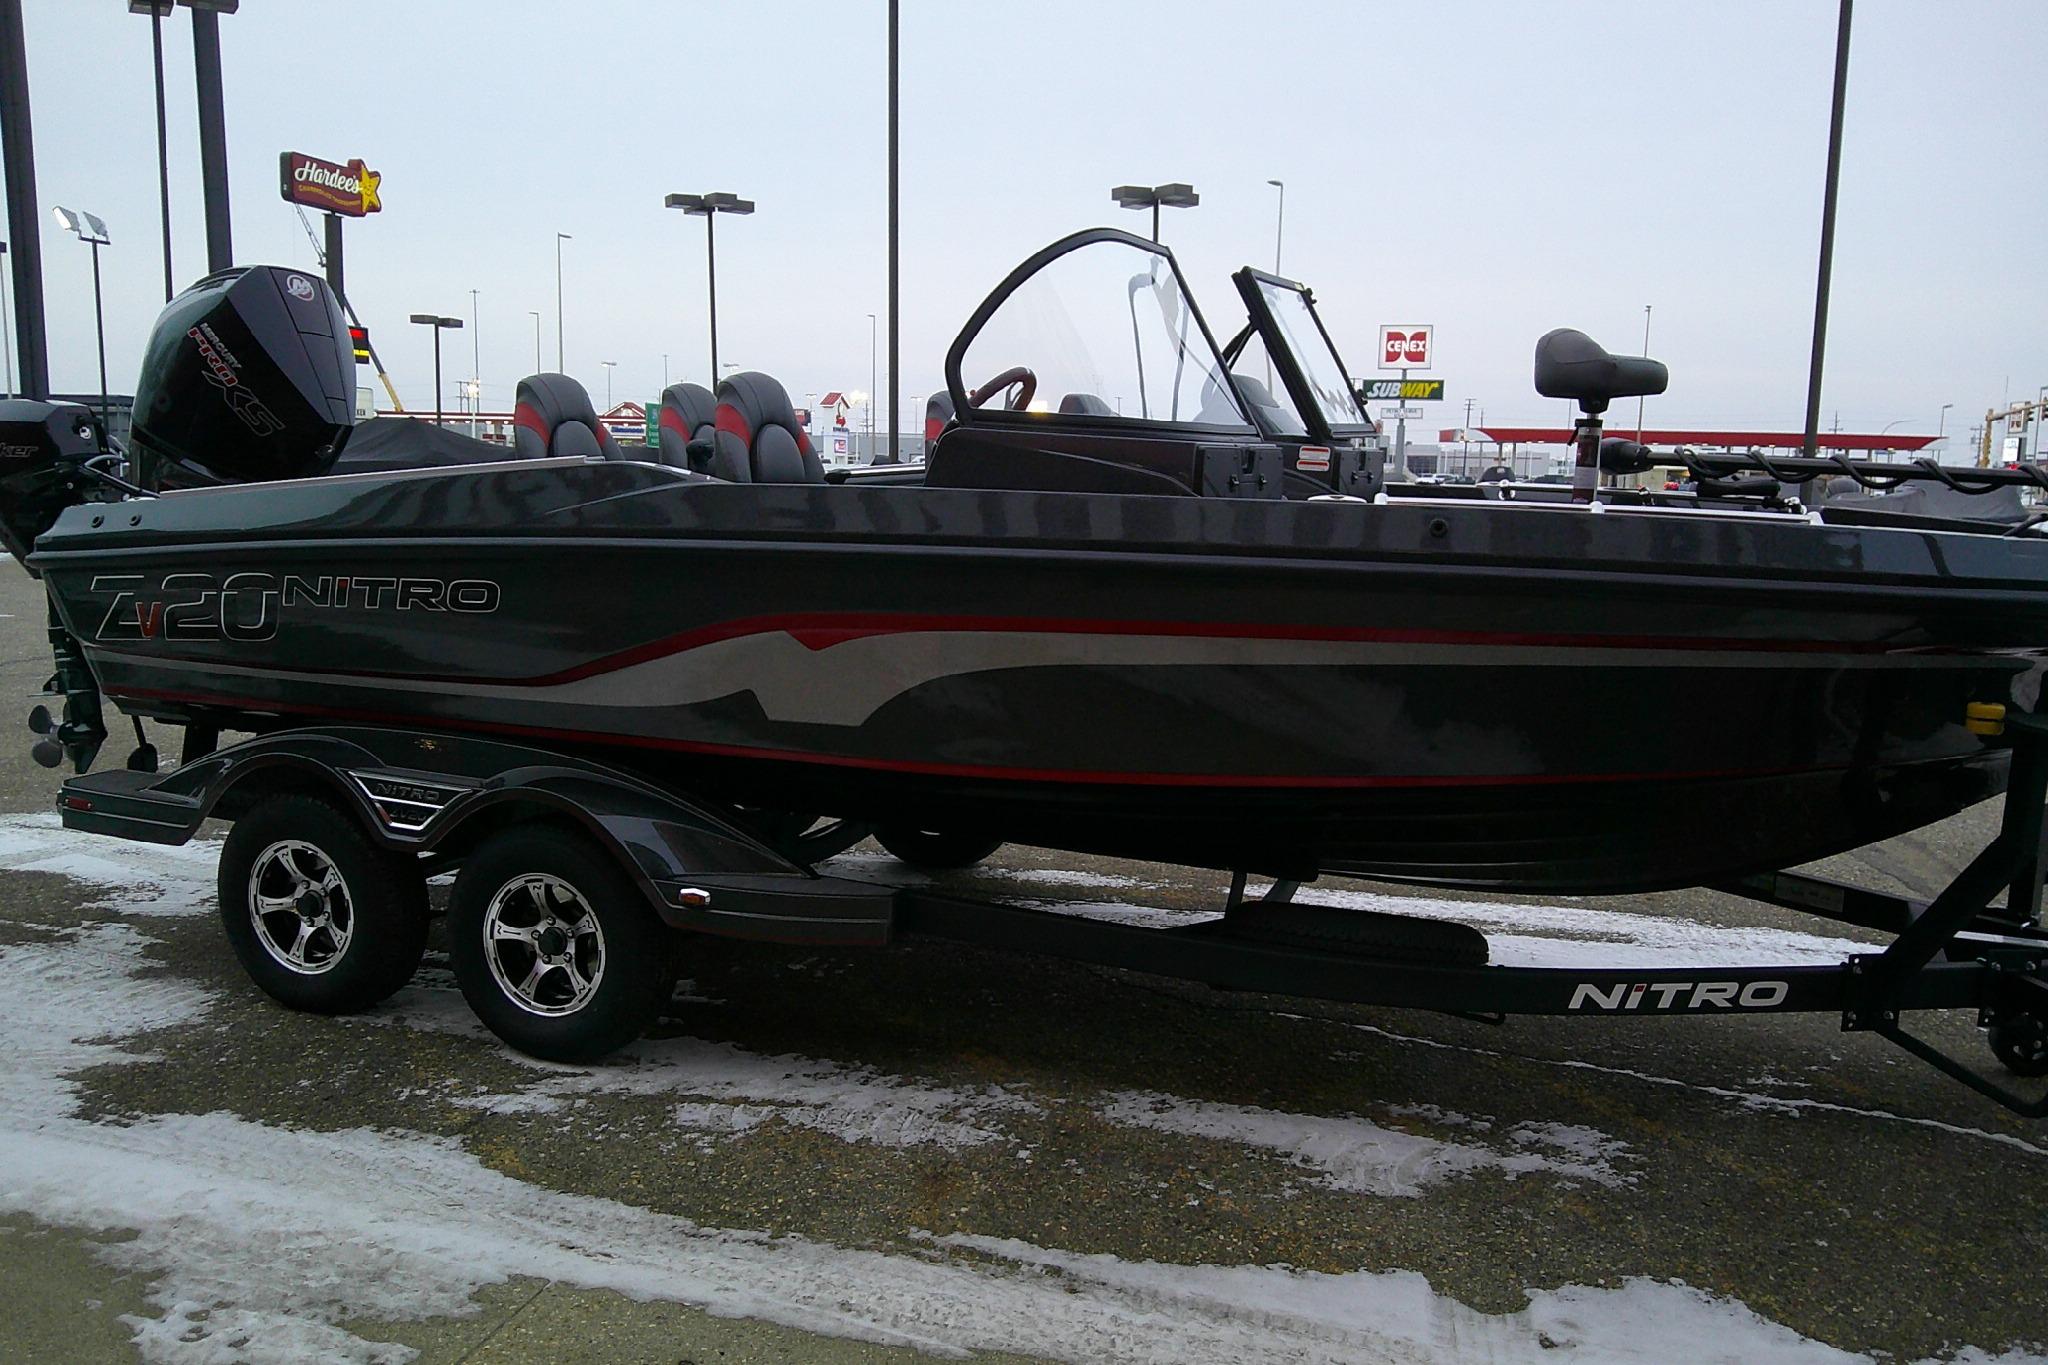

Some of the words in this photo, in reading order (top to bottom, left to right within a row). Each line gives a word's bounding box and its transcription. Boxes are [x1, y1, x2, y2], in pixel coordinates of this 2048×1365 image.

[294, 161, 363, 194] Hardee's
[187, 327, 238, 387] PRO
[200, 322, 242, 368] MERCURY
[1387, 340, 1426, 352] CENEX
[201, 370, 287, 437] XS
[1366, 382, 1440, 398] SUBWAY
[283, 575, 501, 613] NITRO
[376, 782, 441, 801] NITRO
[1567, 981, 1789, 1009] NITRO
